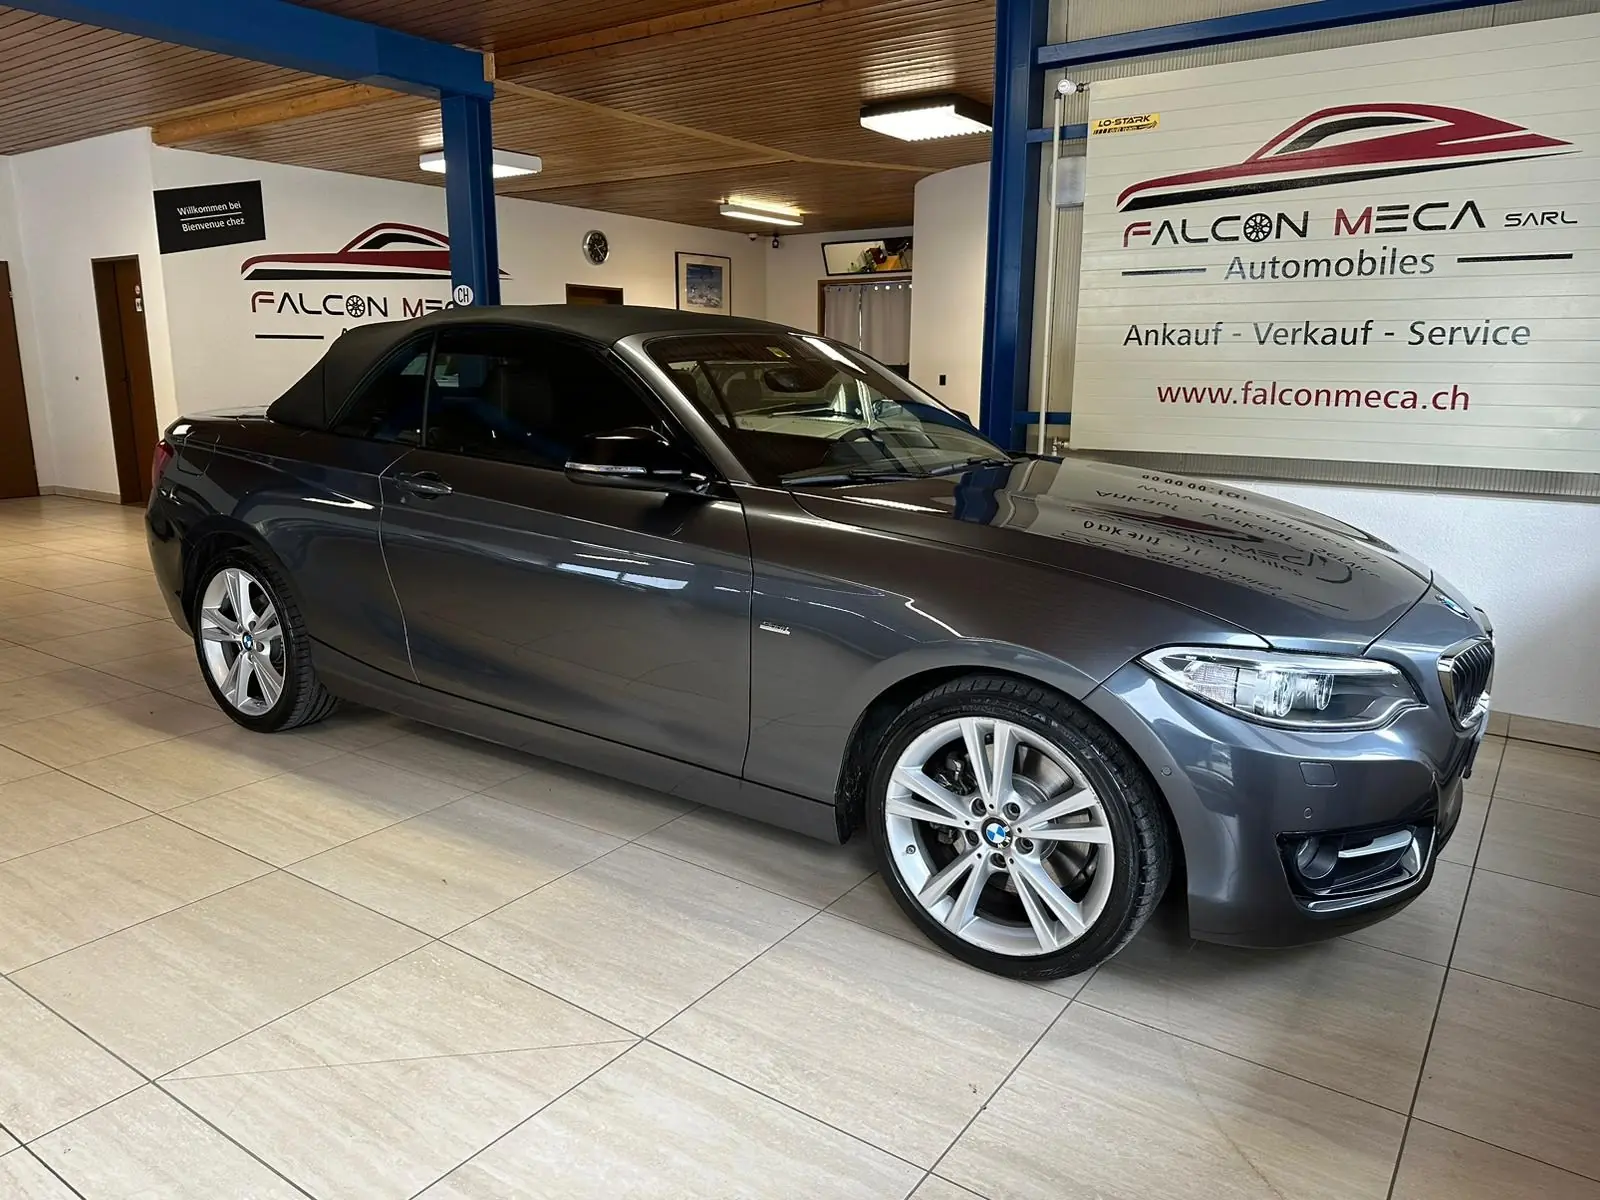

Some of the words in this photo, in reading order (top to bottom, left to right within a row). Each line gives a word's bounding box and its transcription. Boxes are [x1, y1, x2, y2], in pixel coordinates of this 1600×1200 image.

[177, 204, 228, 215] Willkommen
[229, 201, 241, 210] bei
[182, 220, 225, 232] Bienvenue
[226, 217, 246, 226] chez
[1123, 210, 1309, 247] FALCON
[1334, 200, 1486, 236] MECA
[1504, 211, 1578, 227] SARL
[1224, 246, 1435, 280] Automobiles
[251, 290, 388, 318] FALCON
[457, 287, 470, 303] CH
[1123, 321, 1223, 346] Ankauf
[1253, 320, 1374, 346] Verkauf
[1407, 319, 1531, 346] Service
[1157, 381, 1471, 411] www.falconmeca.ch
